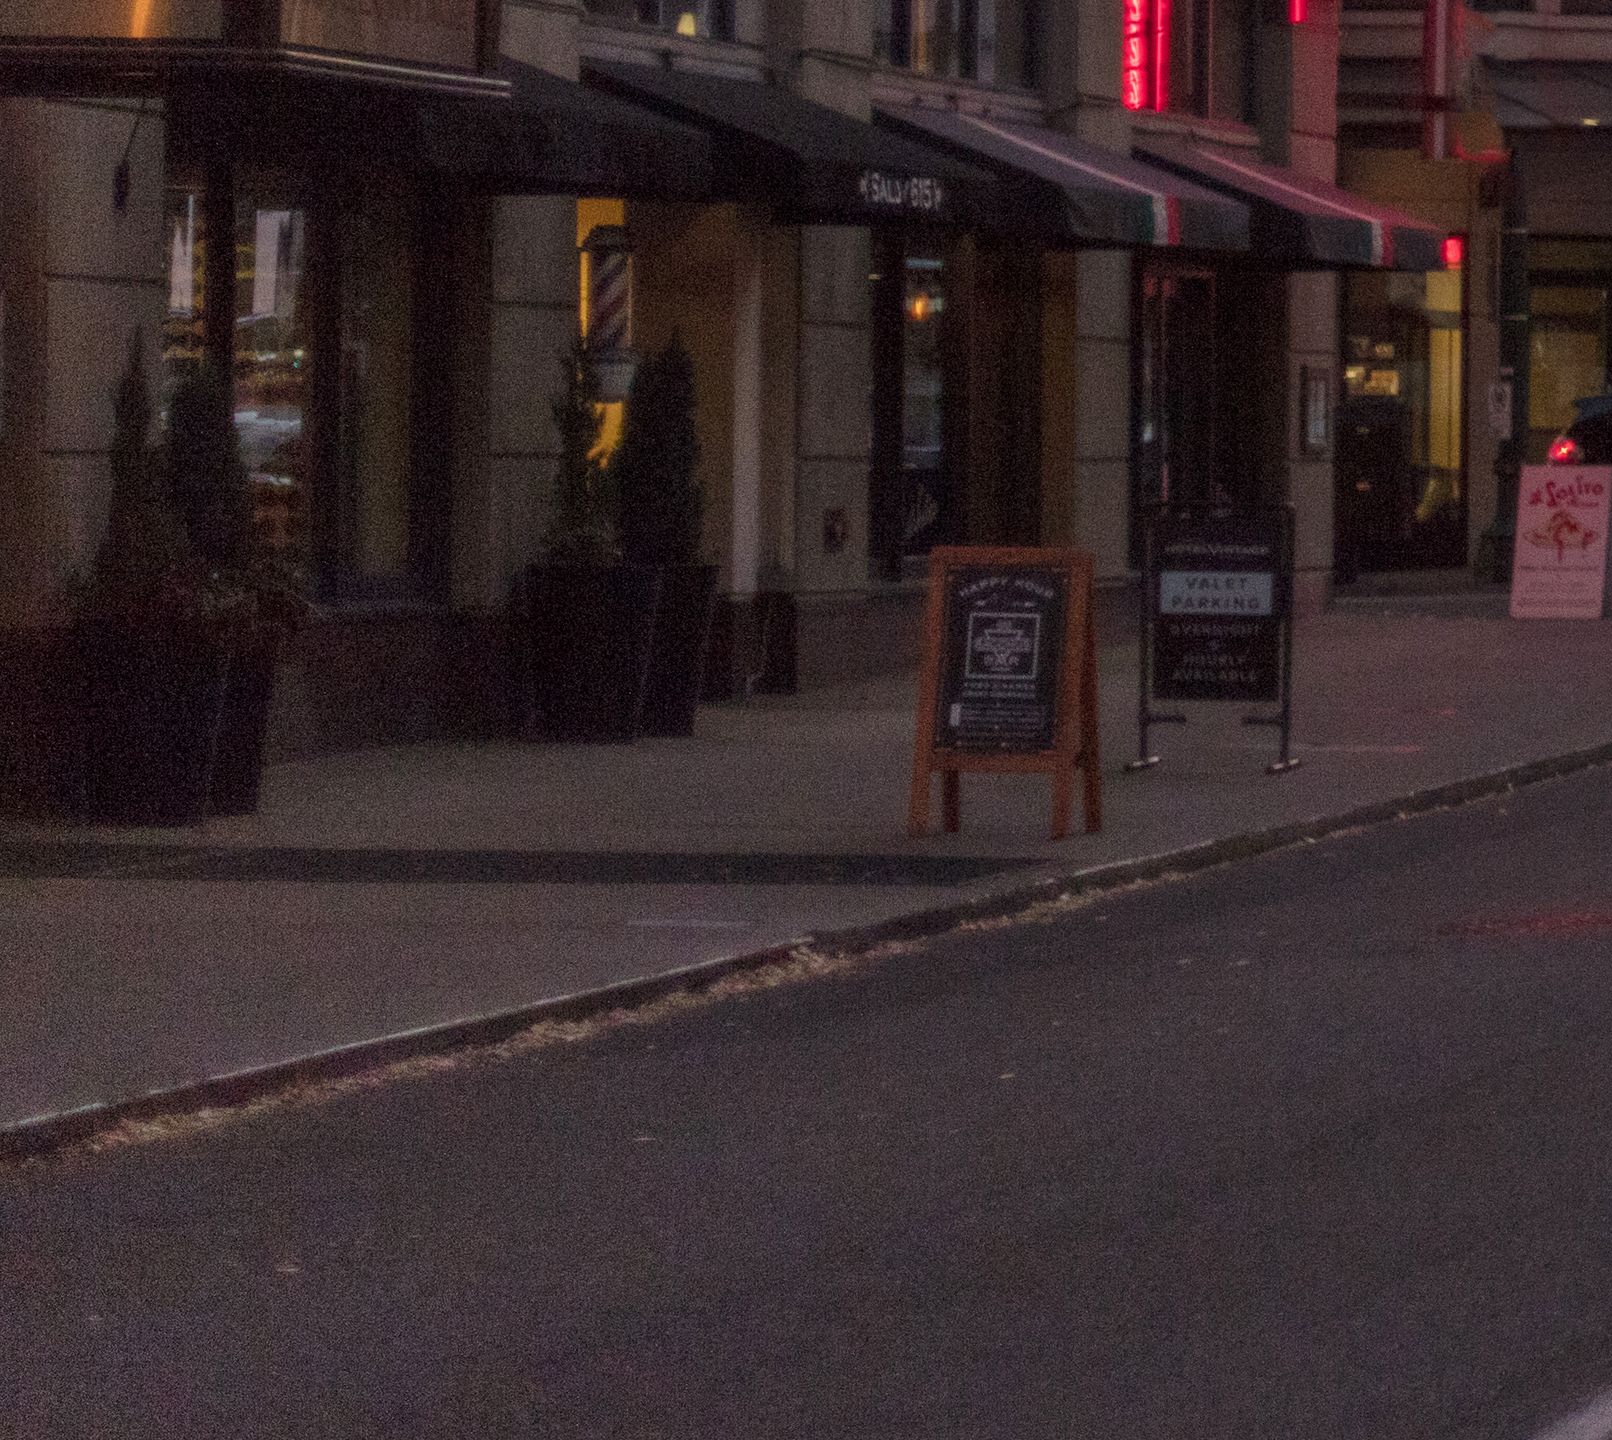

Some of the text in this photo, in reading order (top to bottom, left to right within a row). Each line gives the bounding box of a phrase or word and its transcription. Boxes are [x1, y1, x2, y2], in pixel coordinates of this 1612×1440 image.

[960, 576, 1054, 599] HAPPY HOUR
[1185, 577, 1248, 591] VALET
[1171, 597, 1260, 610] PARKING
[1172, 668, 1260, 681] AVAILABLE
